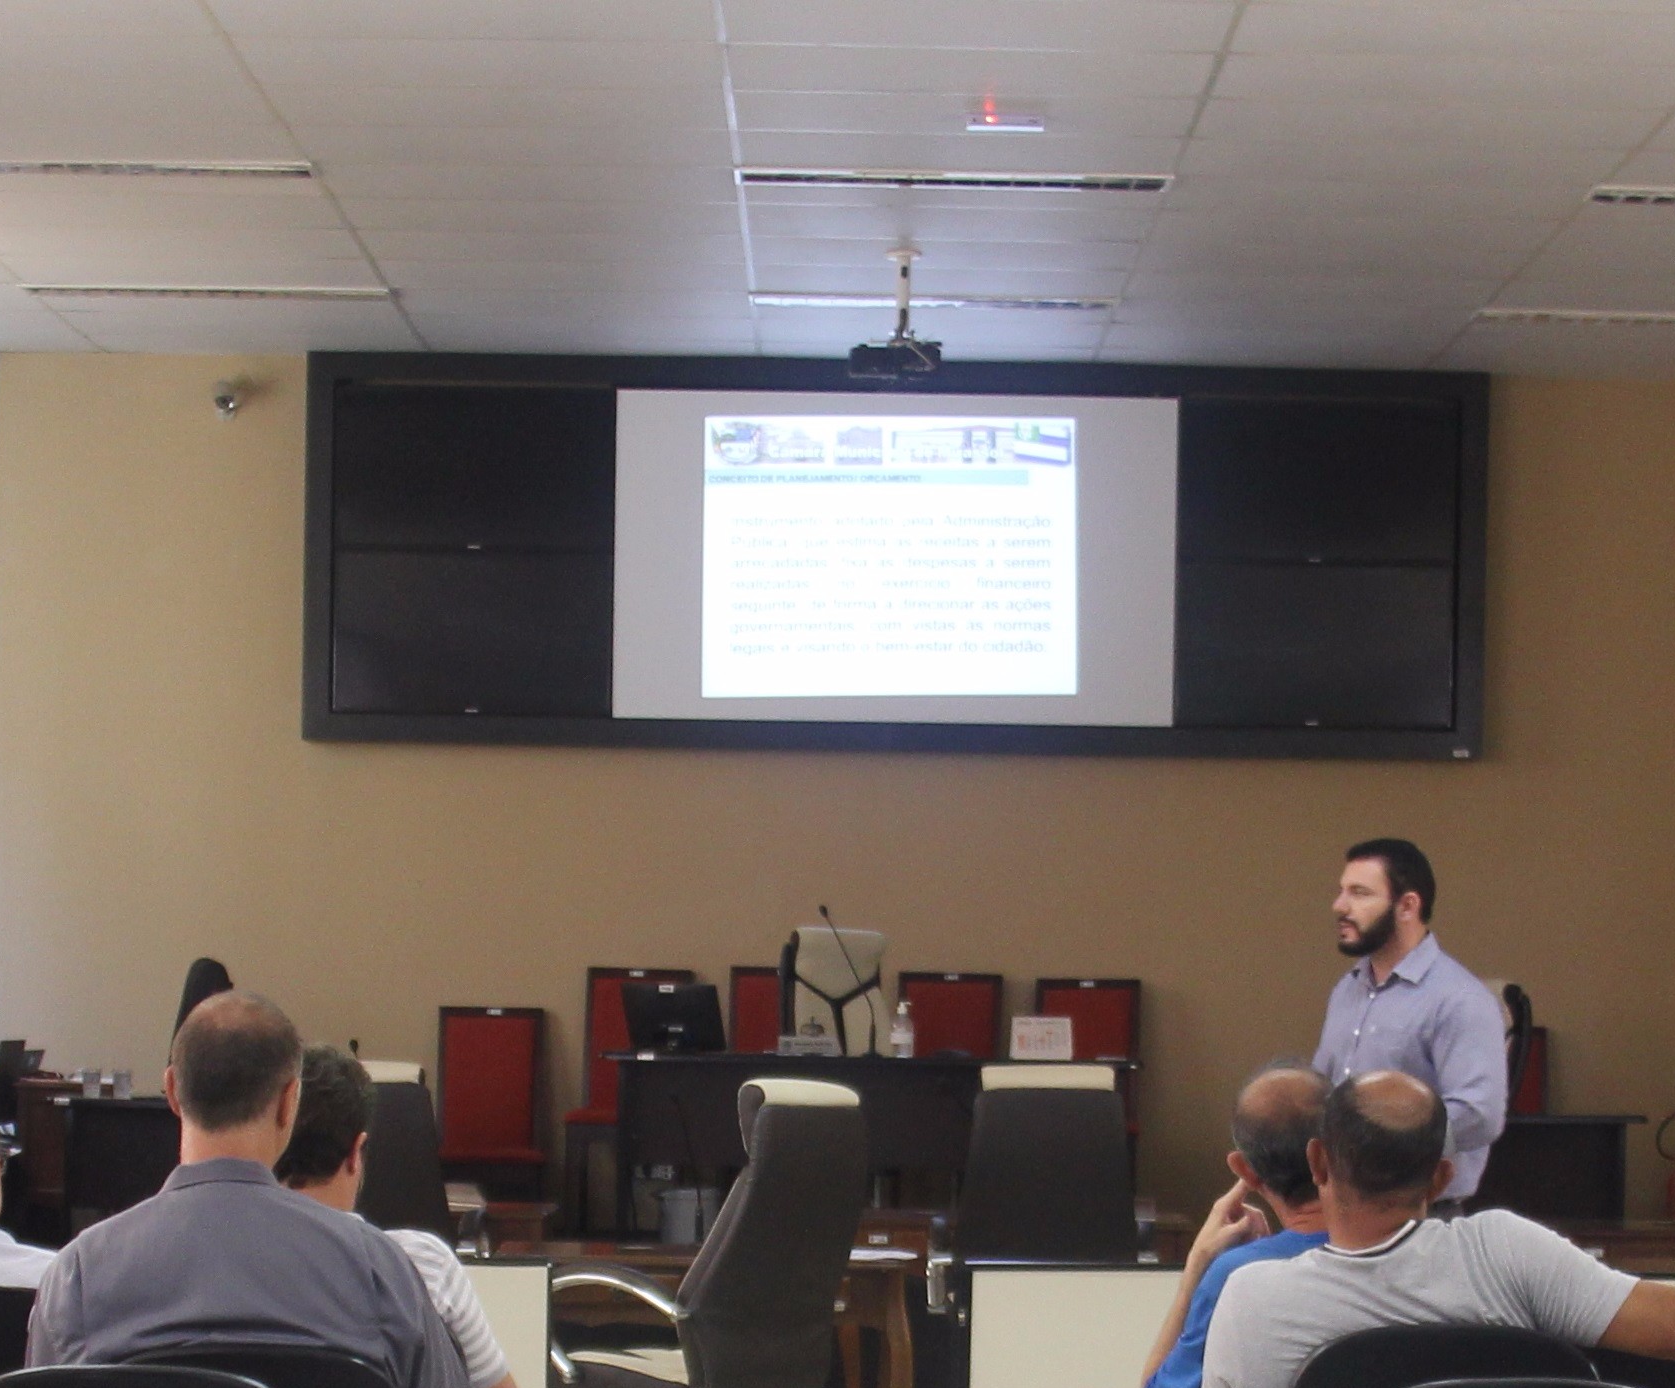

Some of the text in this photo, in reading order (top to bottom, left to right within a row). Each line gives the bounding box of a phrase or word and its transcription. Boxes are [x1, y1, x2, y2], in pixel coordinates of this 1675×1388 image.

[760, 473, 774, 484] DE
[942, 514, 1052, 530] Administração
[986, 538, 996, 548] a
[1004, 538, 1052, 548] serem
[902, 556, 977, 571] despesas
[1003, 558, 1052, 569] serem
[976, 575, 1052, 589] financeiro
[900, 598, 975, 610] direcionar
[981, 600, 999, 610] as
[1005, 598, 1052, 613] ações
[912, 619, 956, 631] vistas
[993, 620, 1052, 632] normas
[958, 640, 978, 653] do
